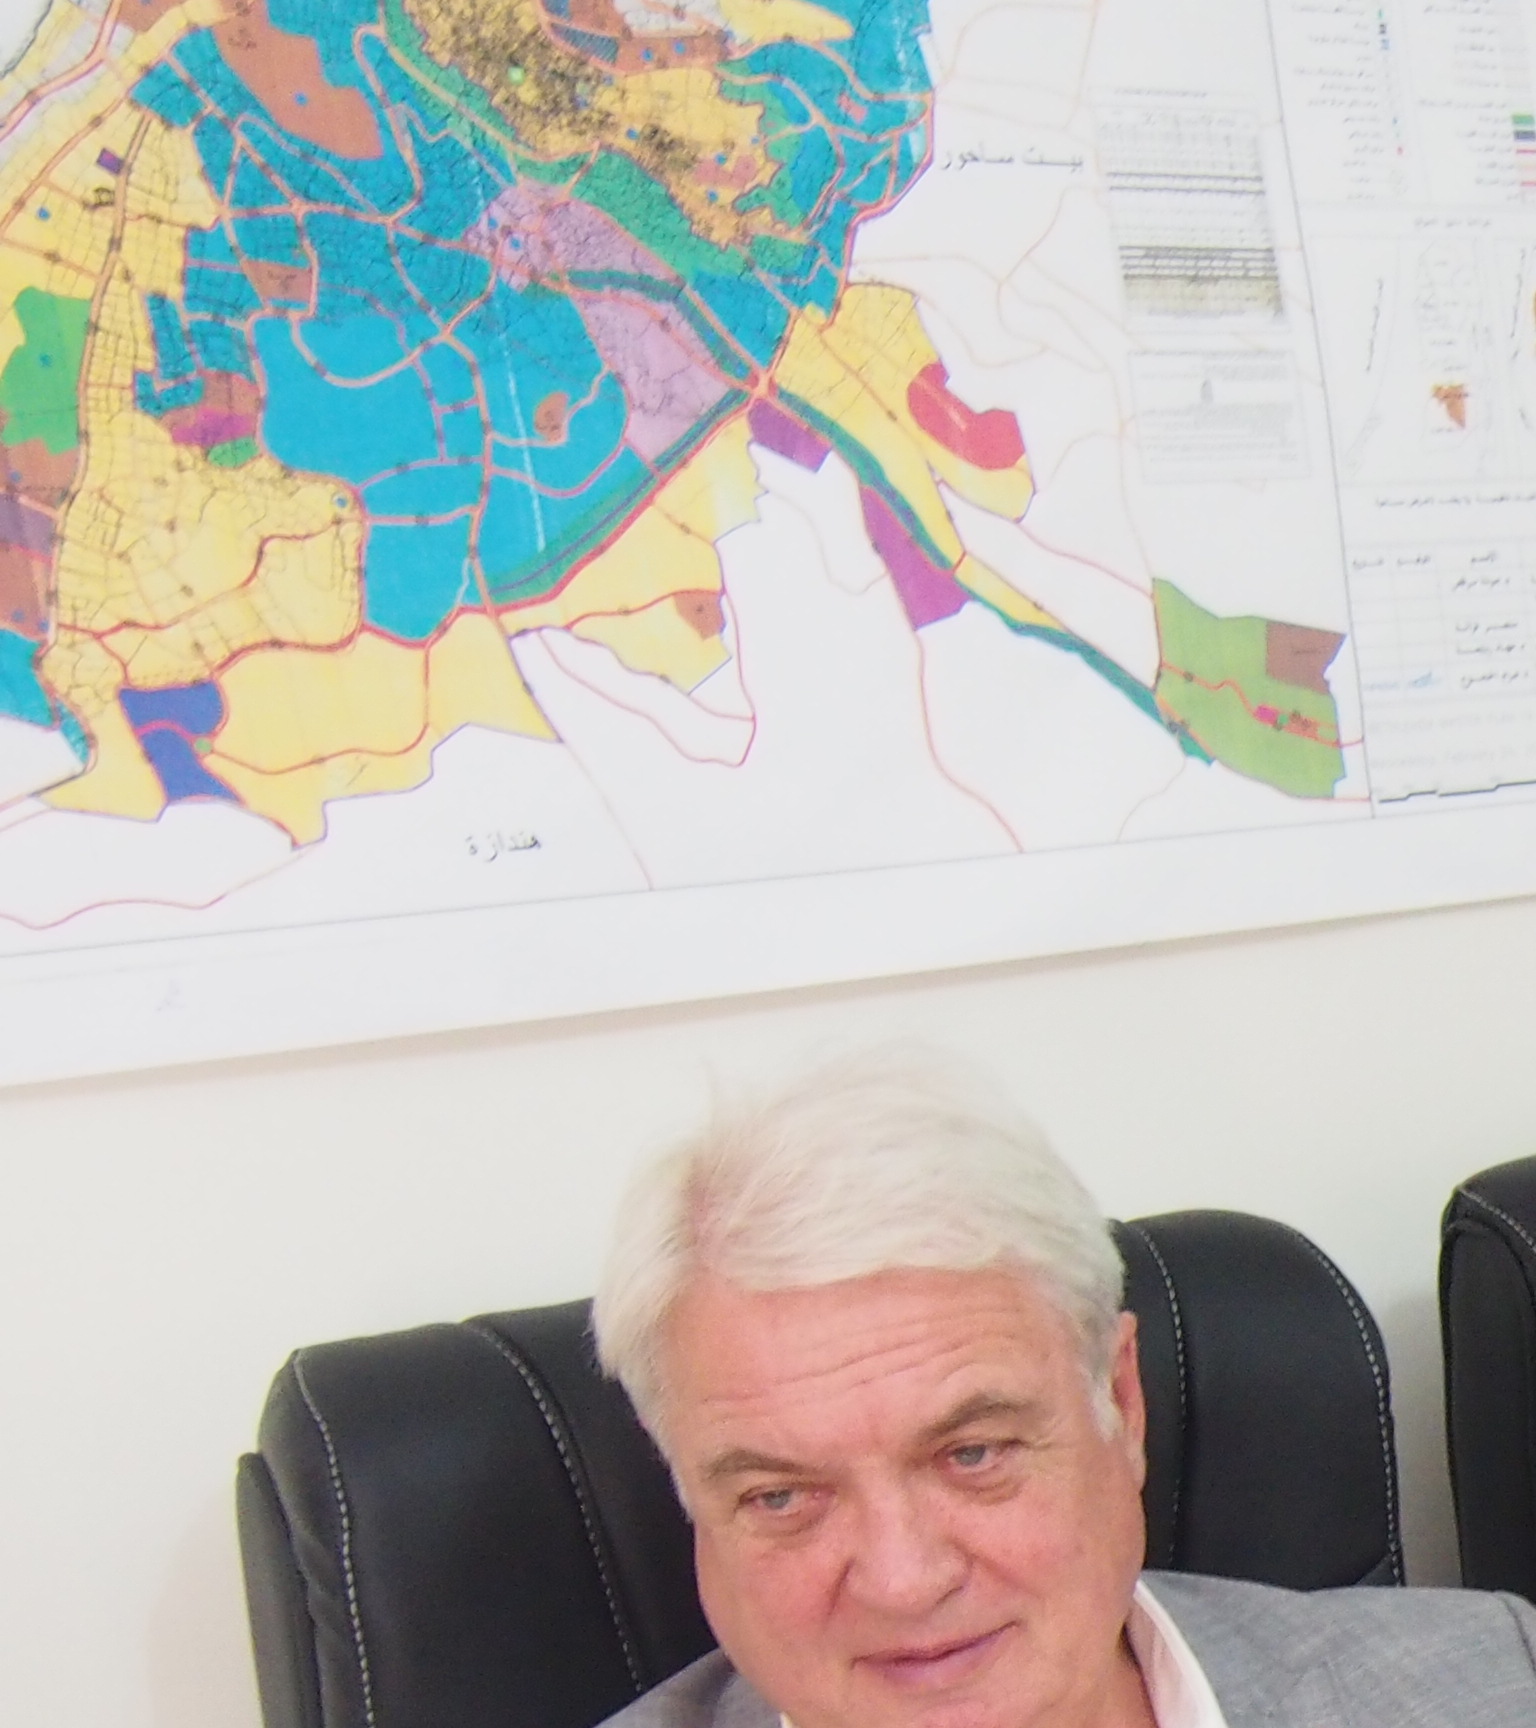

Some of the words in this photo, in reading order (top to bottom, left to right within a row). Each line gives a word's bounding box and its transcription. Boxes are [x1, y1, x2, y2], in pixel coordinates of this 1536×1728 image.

[940, 141, 1015, 171] ساحور
[1022, 145, 1084, 174] بيت
[465, 830, 542, 864] هندازة
